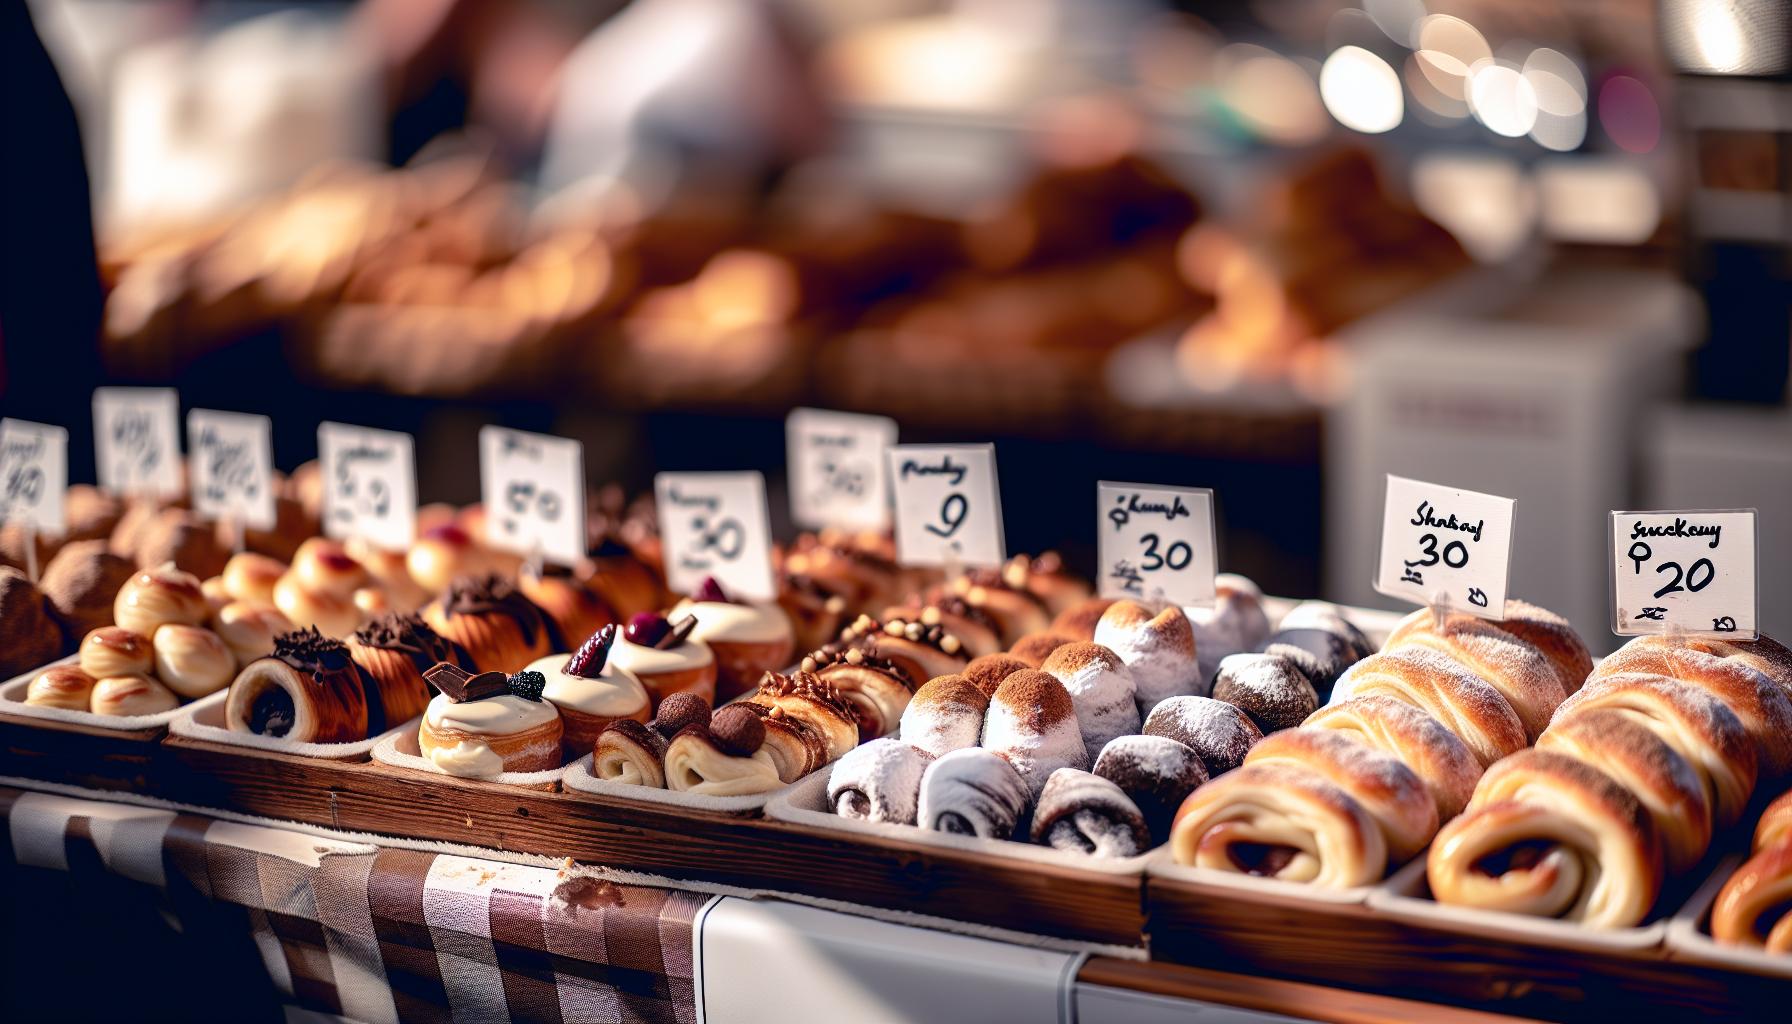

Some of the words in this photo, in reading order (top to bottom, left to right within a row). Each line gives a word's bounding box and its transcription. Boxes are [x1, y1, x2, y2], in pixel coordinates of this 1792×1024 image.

[1139, 532, 1193, 571] 30
[1404, 533, 1469, 569] 30
[1653, 557, 1715, 599] 20
